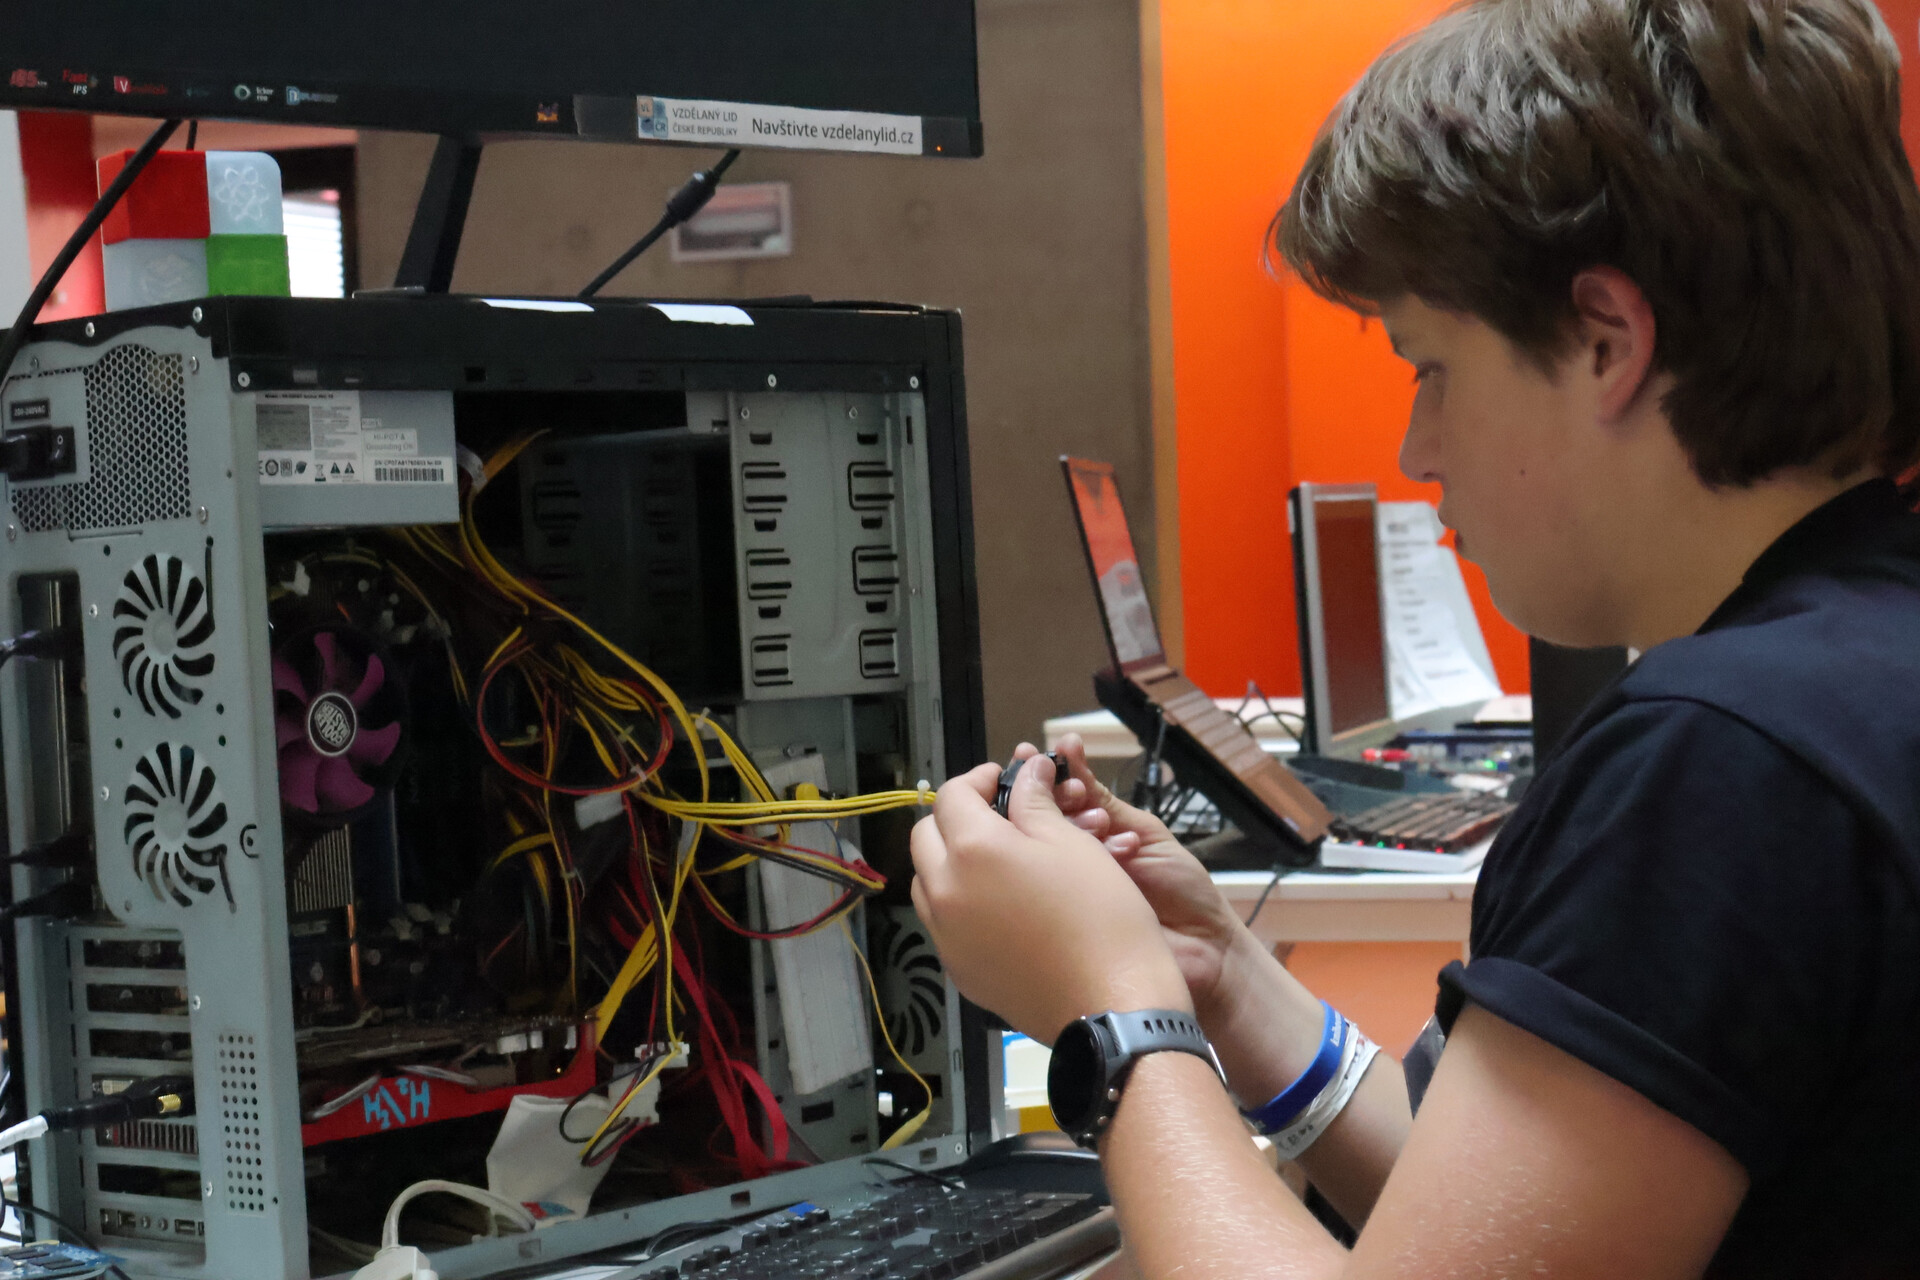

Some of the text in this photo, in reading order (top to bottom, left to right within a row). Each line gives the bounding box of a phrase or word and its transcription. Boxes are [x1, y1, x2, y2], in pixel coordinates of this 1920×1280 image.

[73, 84, 87, 95] IPS
[723, 112, 738, 121] LID
[698, 126, 738, 137] REPUBLIKY
[752, 118, 914, 146] Navštivte vzdelanylid.cz
